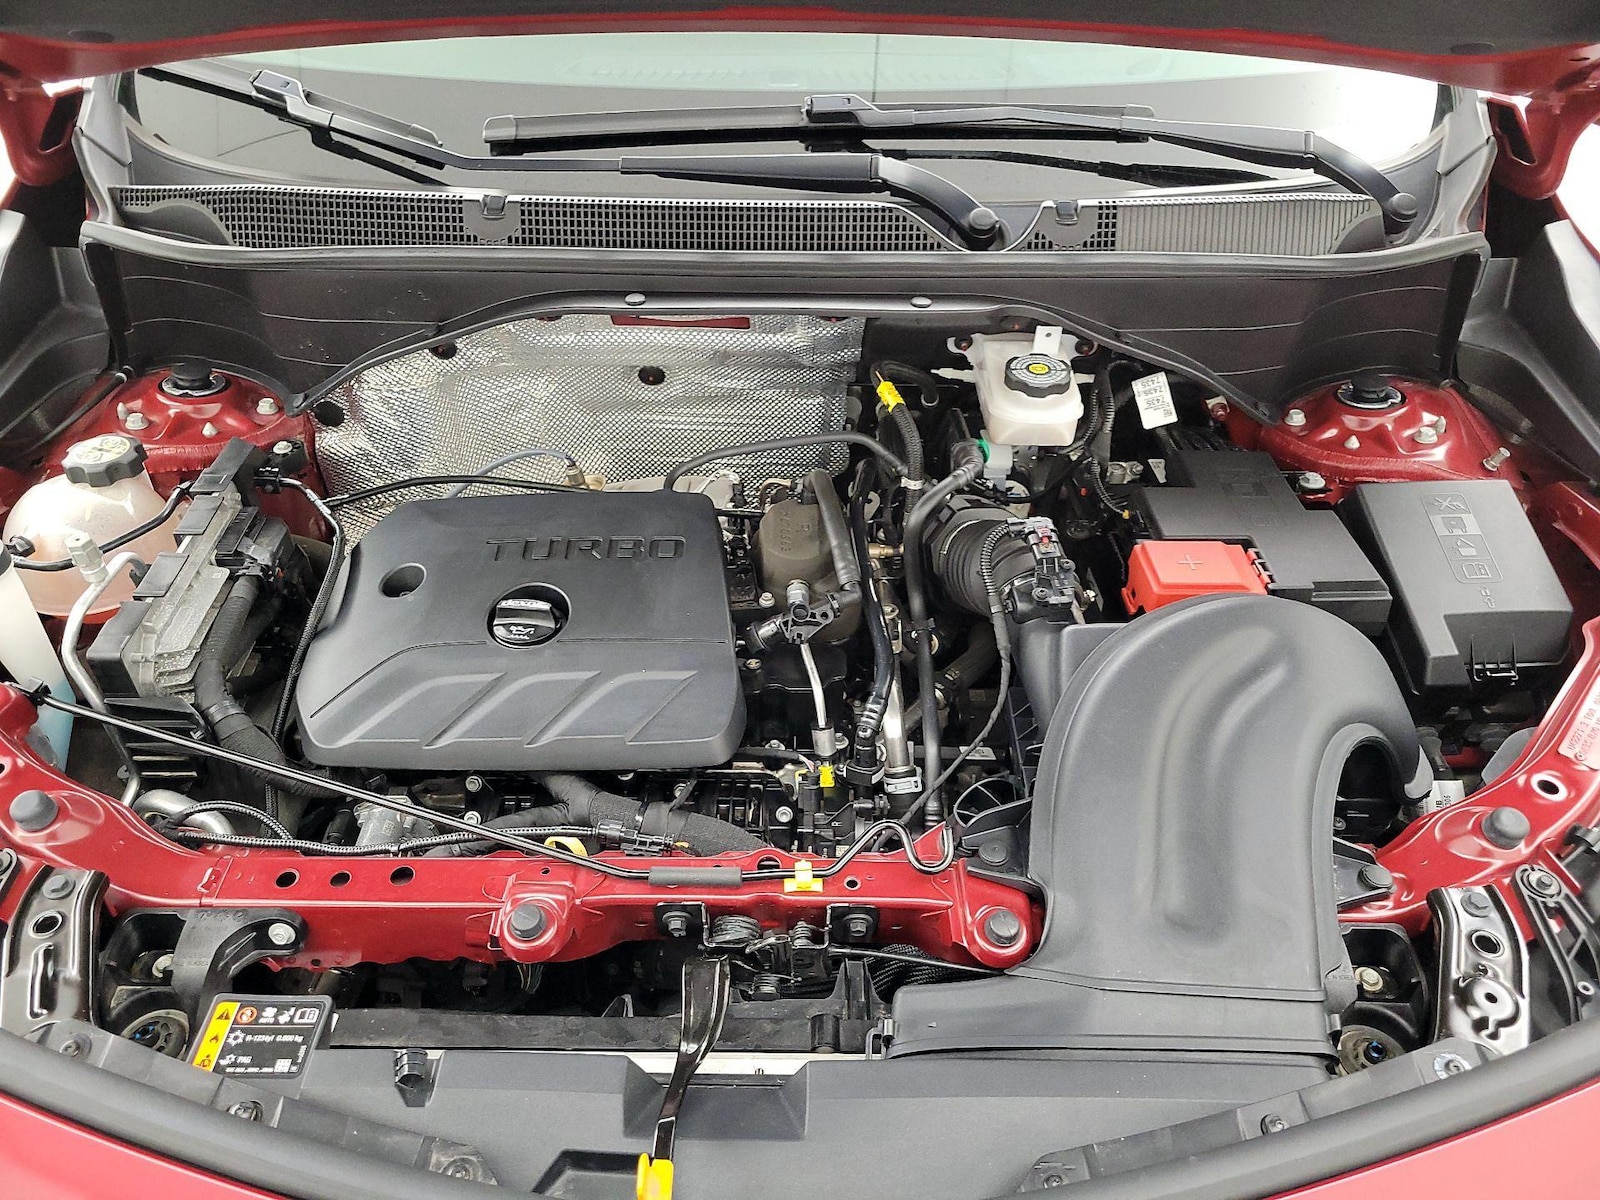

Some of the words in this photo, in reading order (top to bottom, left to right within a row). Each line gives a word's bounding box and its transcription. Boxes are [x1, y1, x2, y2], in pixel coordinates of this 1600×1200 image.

[486, 535, 686, 561] TURBO
[295, 1034, 304, 1043] kg
[236, 1056, 252, 1064] PAG
